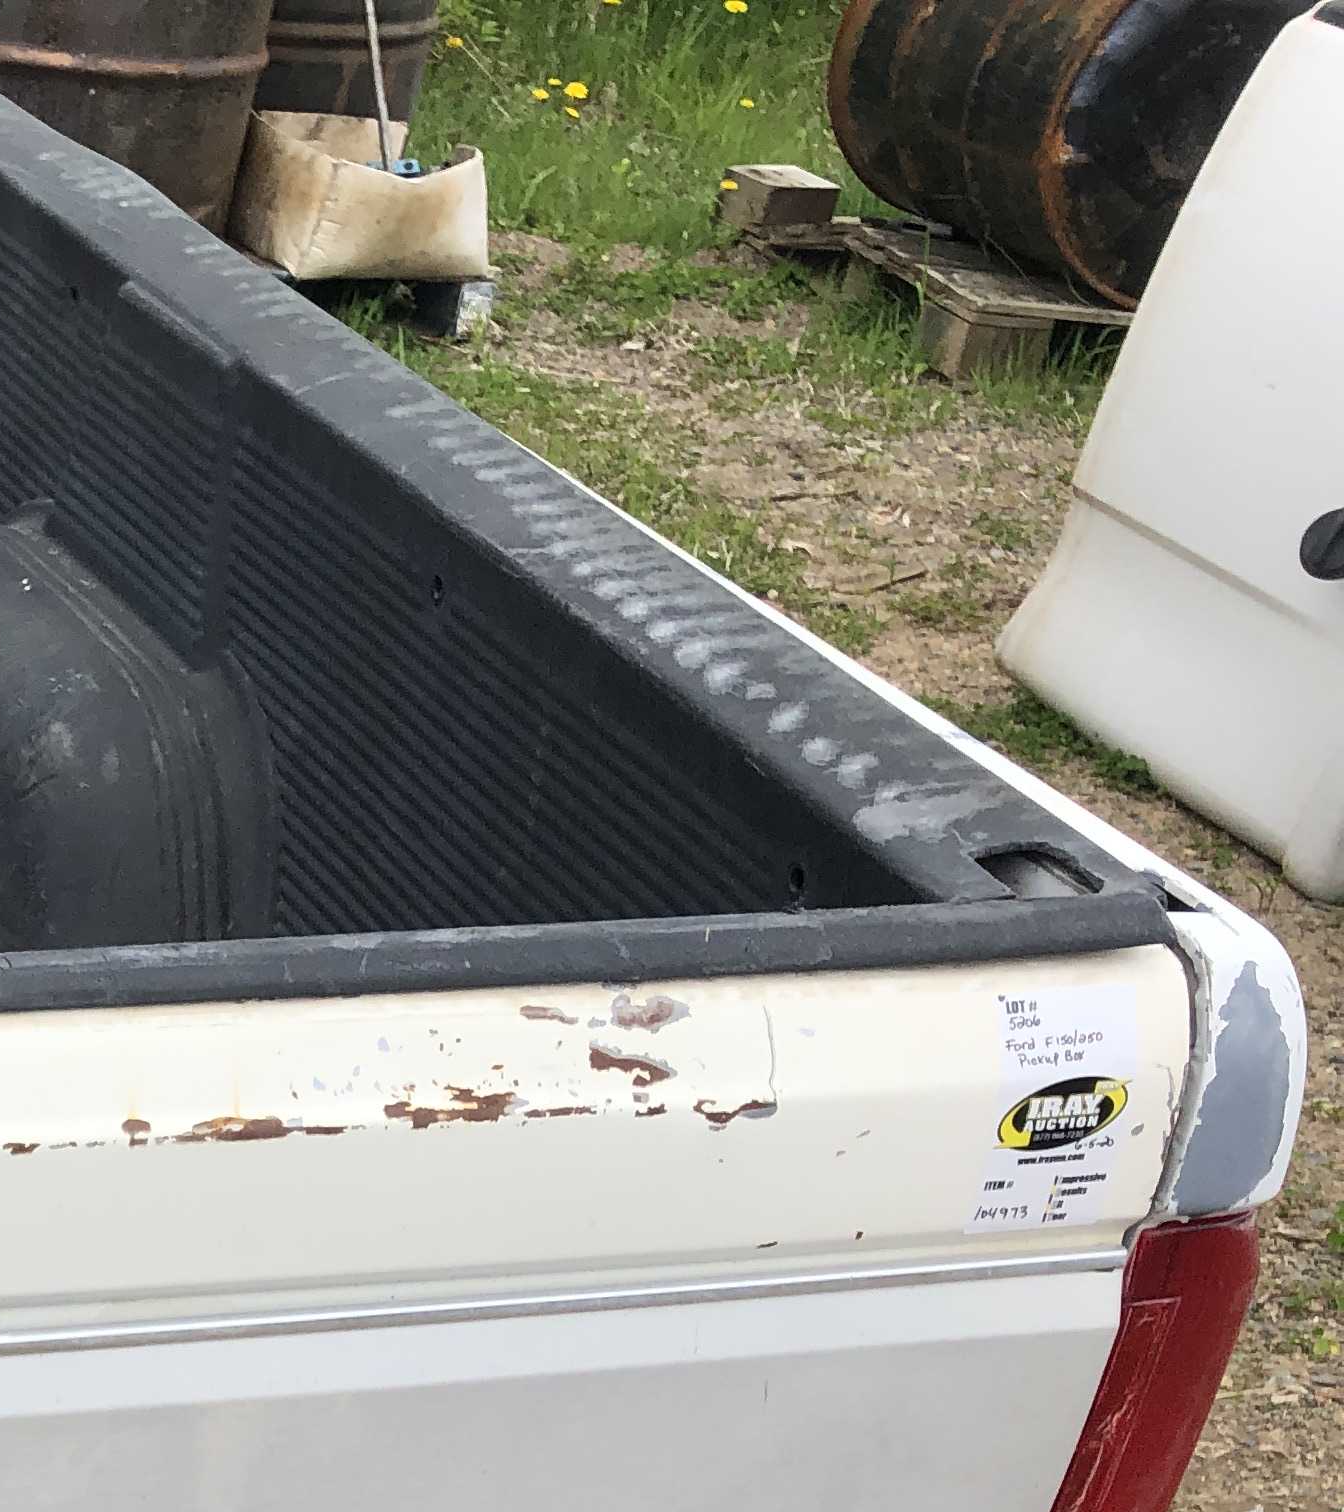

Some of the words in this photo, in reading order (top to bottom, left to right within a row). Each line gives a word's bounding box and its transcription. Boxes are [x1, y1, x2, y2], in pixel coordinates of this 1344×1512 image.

[1006, 1000, 1026, 1014] LOT
[1009, 1015, 1041, 1031] 5206
[1005, 1037, 1036, 1053] Ford
[1018, 1053, 1059, 1068] Pickup
[1065, 1049, 1085, 1062] Box
[1023, 1115, 1100, 1133] AUCTION
[983, 1180, 1005, 1191] ITEM
